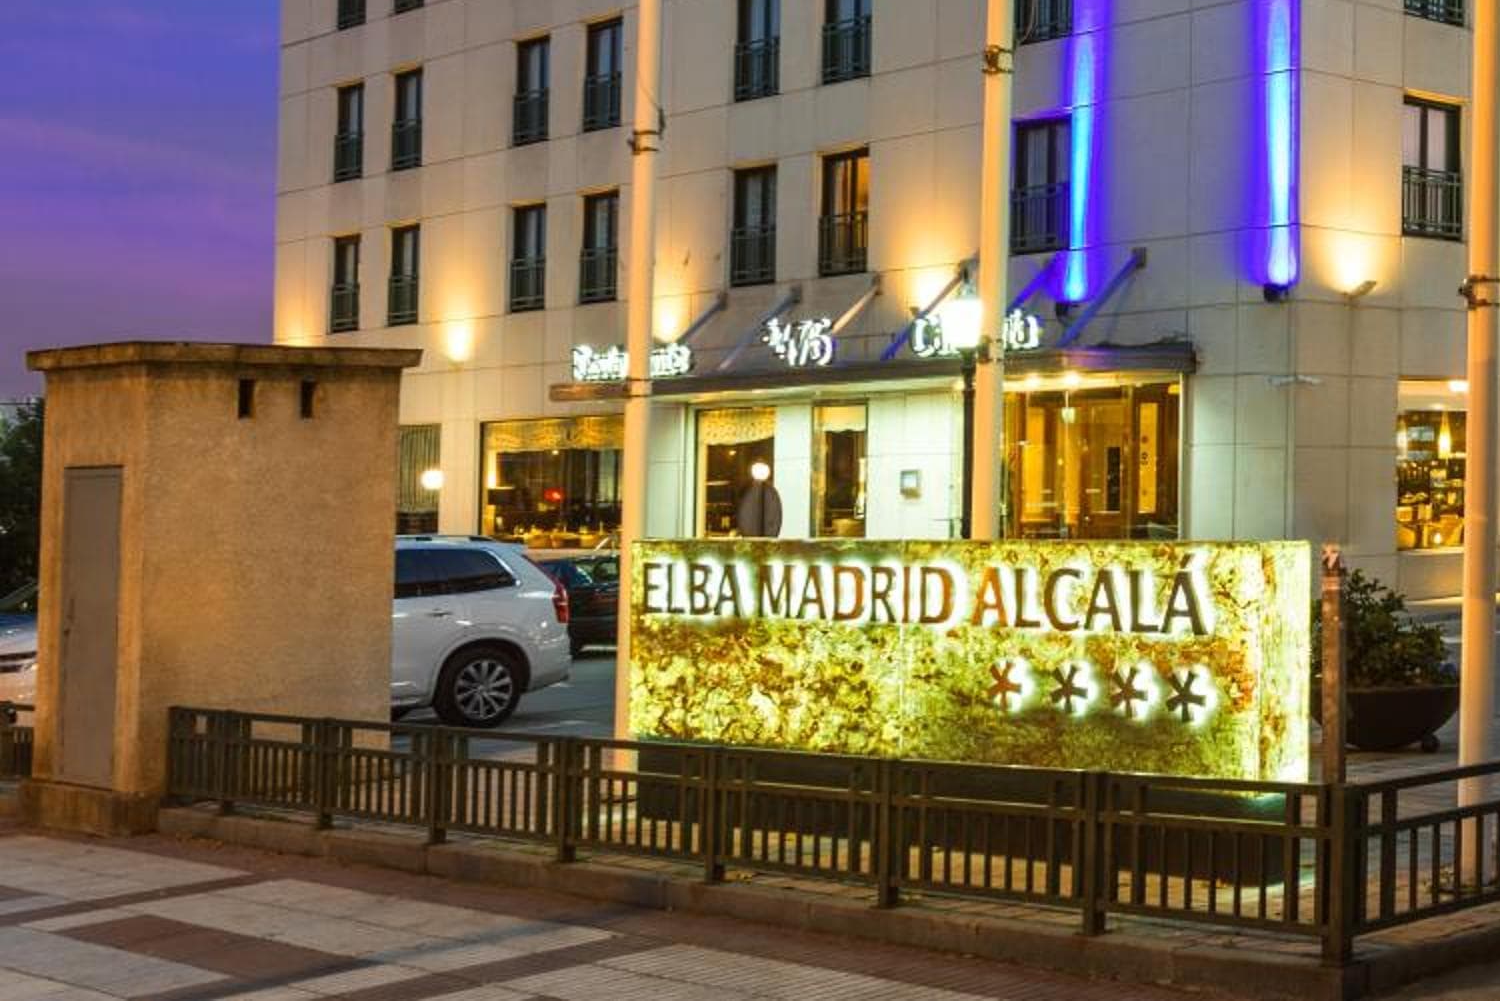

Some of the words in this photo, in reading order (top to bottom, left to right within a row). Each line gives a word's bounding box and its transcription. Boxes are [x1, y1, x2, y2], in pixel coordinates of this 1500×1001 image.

[642, 561, 742, 619] ELBA
[756, 563, 955, 627] MADRID
[972, 553, 1211, 637] ALCALÁ
